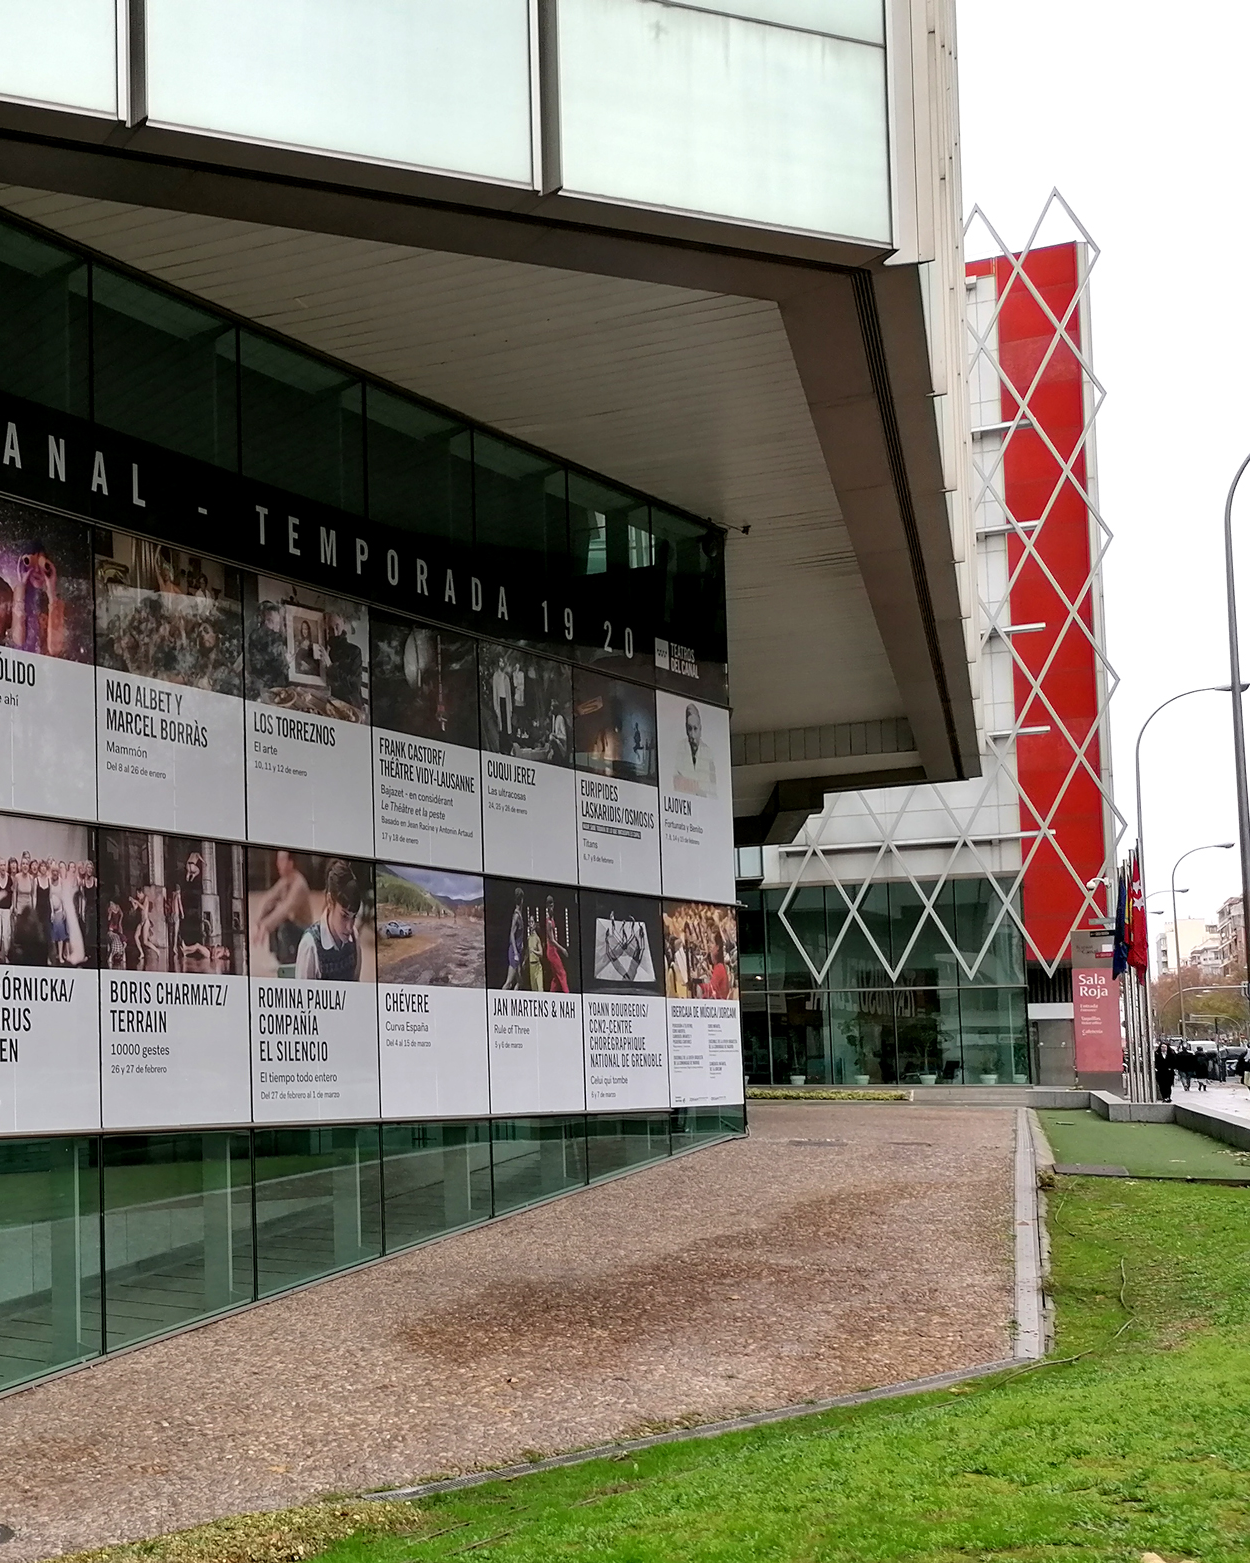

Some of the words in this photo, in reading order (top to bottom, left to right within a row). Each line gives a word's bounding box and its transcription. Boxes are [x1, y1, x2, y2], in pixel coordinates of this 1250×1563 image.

[197, 506, 208, 515] -
[256, 505, 509, 621] TEMPORADA
[541, 600, 573, 641] 19
[603, 621, 634, 660] 20
[670, 642, 695, 663] TEATROS
[671, 657, 681, 674] DEL
[681, 661, 699, 679] CANAL
[4, 693, 19, 707] ahí
[106, 679, 131, 706] NAO
[134, 685, 171, 714] ALBET
[175, 694, 183, 715] Y
[106, 707, 157, 739] MARCEL
[160, 718, 208, 748] BORRÀS
[254, 711, 273, 735] LOS
[276, 716, 336, 747] TORREZNOS
[106, 741, 148, 759] Mammón
[254, 741, 261, 752] El
[262, 744, 278, 756] arte
[379, 737, 407, 759] FRANK
[408, 743, 446, 767] CASTORF/
[379, 757, 414, 782] THÉÂTRE
[415, 766, 475, 793] VIDY-LAUSANNE
[487, 760, 512, 782] CUQUI
[514, 765, 536, 786] JEREZ
[488, 785, 497, 796] Las
[498, 788, 527, 801] ultracosas
[581, 779, 618, 802] EURIPIDES
[581, 801, 654, 829] LASKARIDIS/OSMOSIS
[664, 796, 691, 817] LAJOVEN
[1078, 973, 1106, 985] Sala
[110, 980, 151, 1004] BORIS
[156, 982, 228, 1006] CHARMATZ/
[258, 987, 304, 1009] ROMINA
[307, 989, 346, 1010] PAULA/
[385, 989, 429, 1013] CHÉVERE
[1080, 985, 1108, 999] Roja
[493, 998, 508, 1016] JAN
[511, 999, 549, 1018] MARTENS
[551, 1000, 558, 1018] &
[560, 1001, 575, 1018] NAH
[588, 1002, 609, 1017] YOANN
[611, 1003, 649, 1018] BOURGEOIS/
[110, 1010, 167, 1033] TERRAIN
[259, 1010, 319, 1035] COMPAÑÍA
[385, 1021, 405, 1032] Curva
[406, 1021, 429, 1034] España
[589, 1019, 632, 1034] CCN2-CENTRE
[111, 1043, 140, 1055] 10000
[142, 1045, 170, 1058] gestes
[259, 1041, 273, 1061] EL
[277, 1040, 328, 1062] SILENCIO
[590, 1033, 646, 1051] CHORÉGRAPHIQUE
[590, 1053, 620, 1068] NATIONAL
[621, 1053, 630, 1067] DE
[631, 1053, 662, 1067] GRENOBLE
[260, 1072, 267, 1083] El
[269, 1072, 295, 1085] tiempo
[296, 1072, 313, 1083] todo
[315, 1073, 338, 1083] entero
